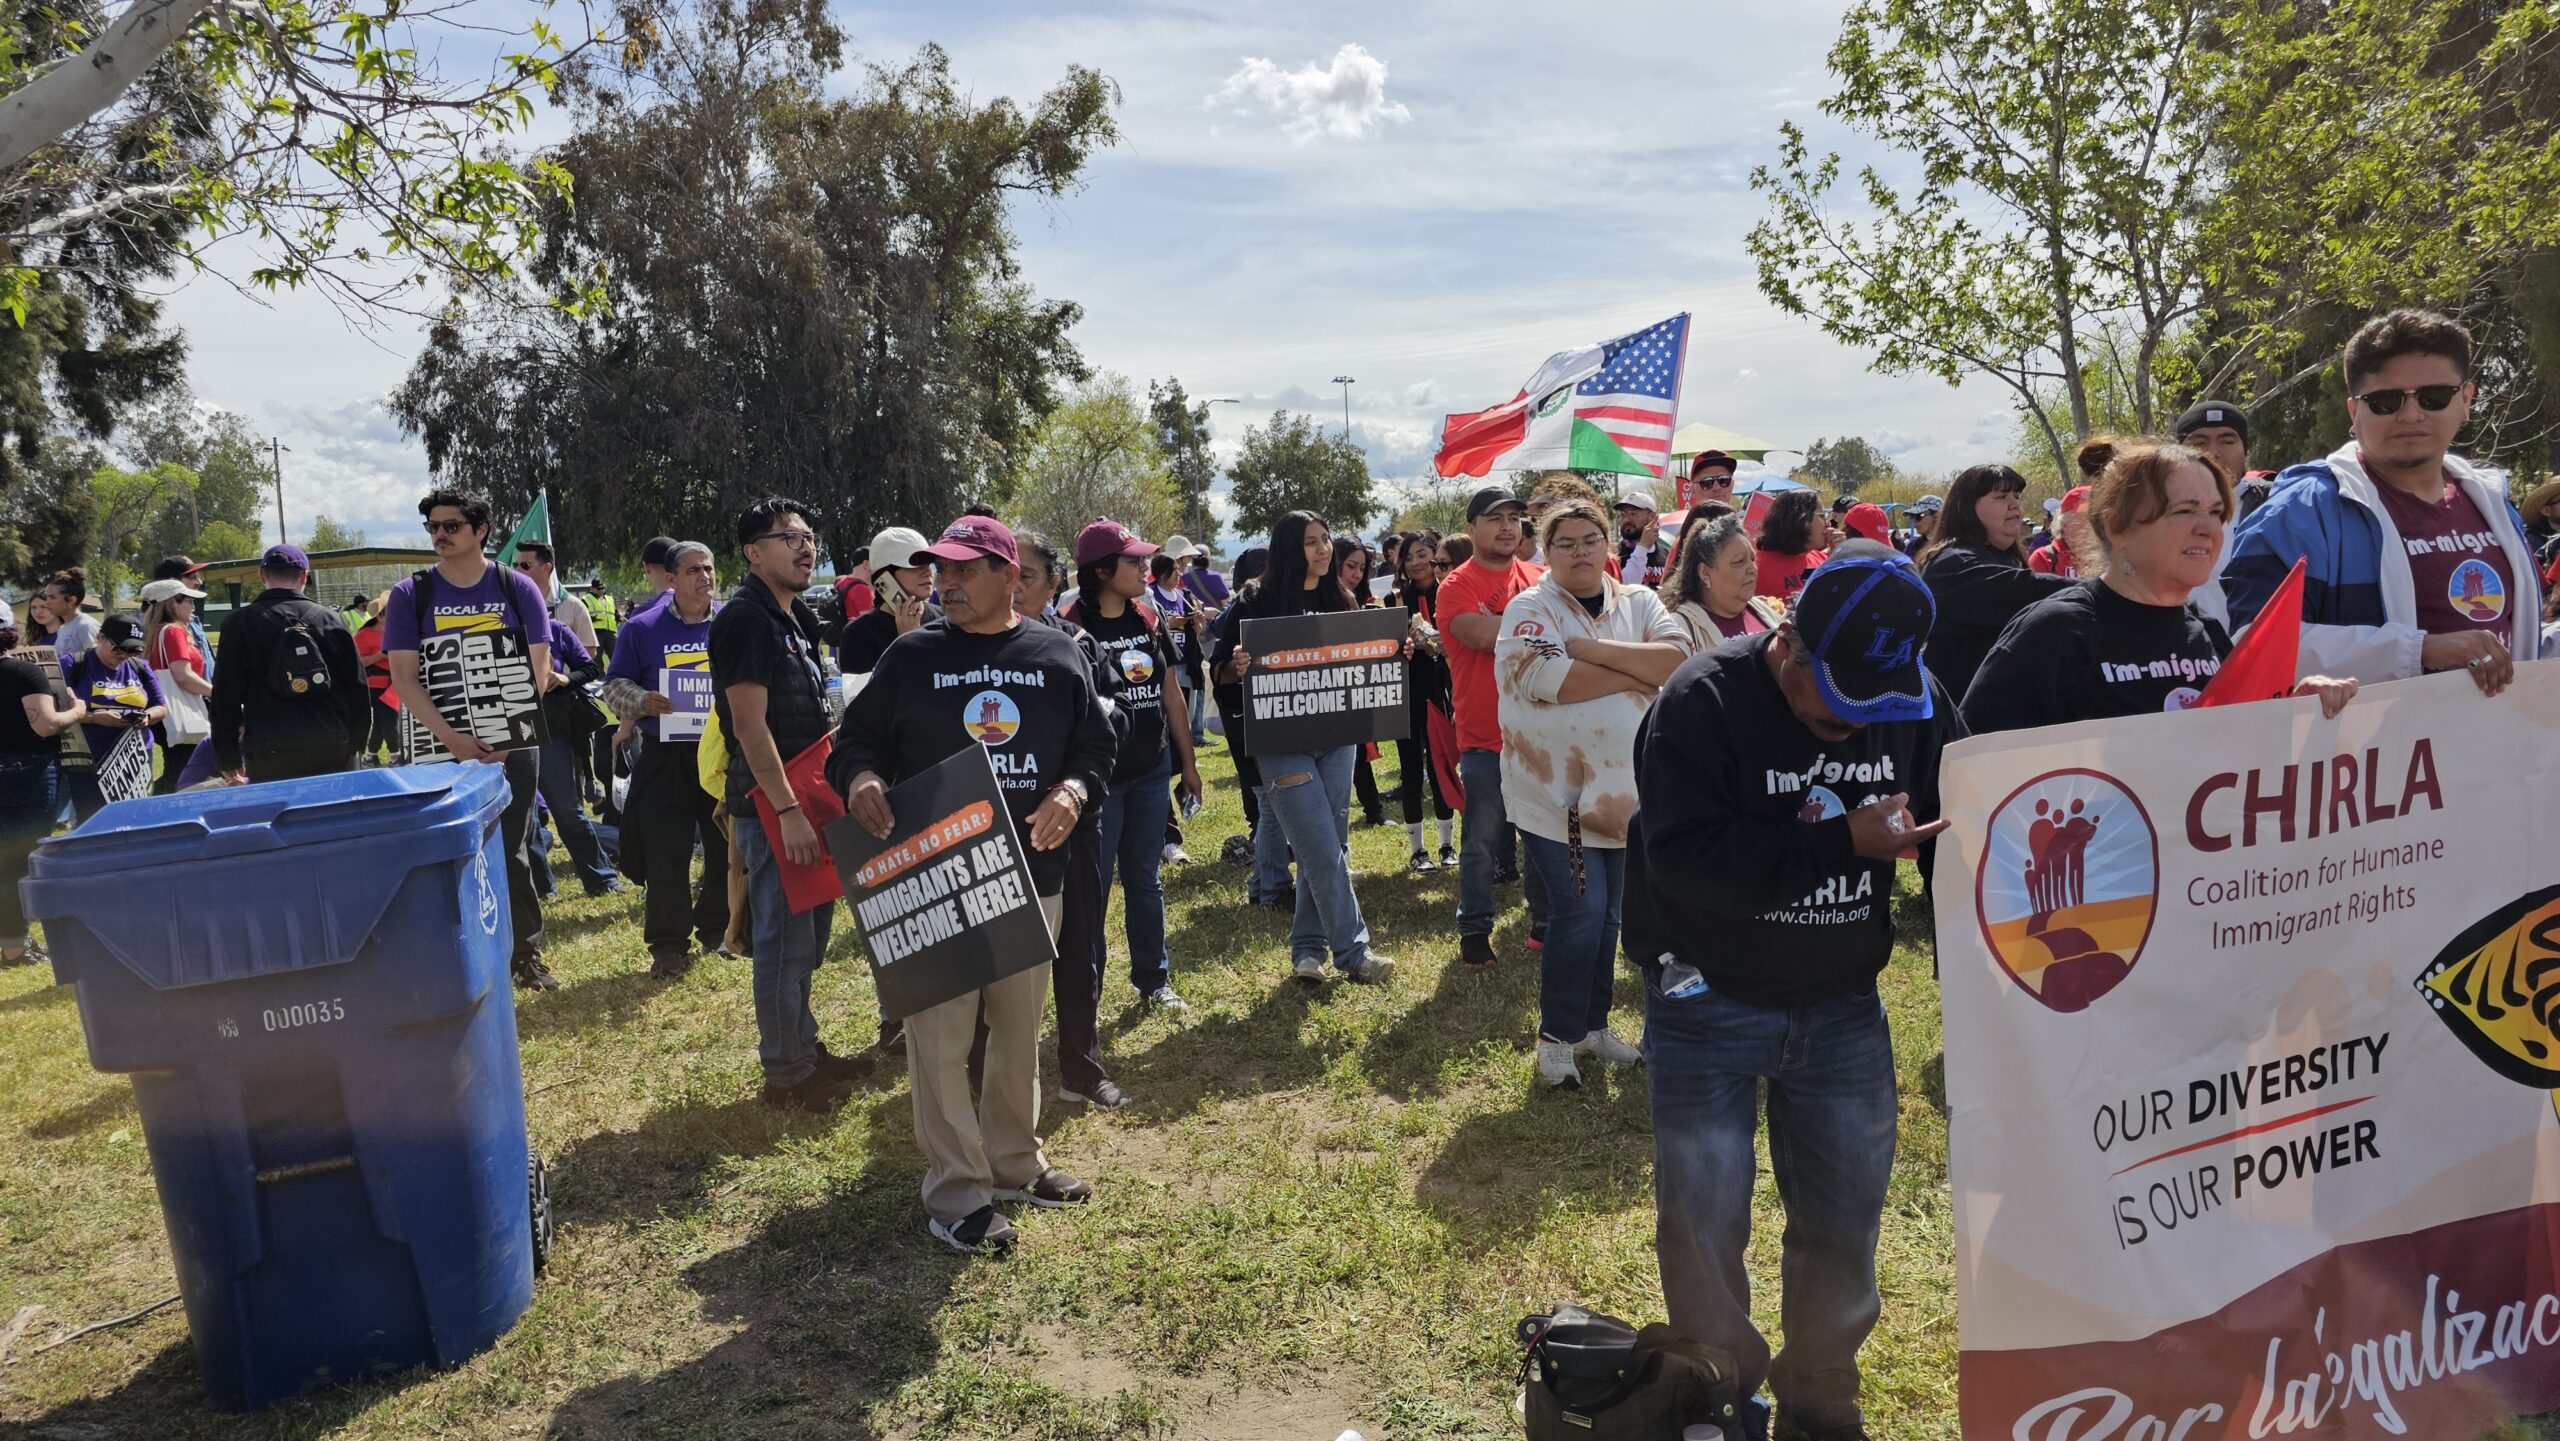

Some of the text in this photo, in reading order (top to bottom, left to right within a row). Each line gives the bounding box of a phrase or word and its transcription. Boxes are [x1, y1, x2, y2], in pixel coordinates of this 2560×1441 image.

[434, 603, 506, 616] LOCAL 721
[664, 642, 707, 653] LOCAL
[1261, 645, 1393, 665] NO HATE, NO FEAR:
[1862, 626, 1915, 672] LA
[462, 635, 512, 744] WE FEED
[495, 656, 538, 718] YOU!
[1252, 661, 1402, 696] IMMIGRANTS ARE
[1253, 684, 1403, 720] WELCOME HERE!
[413, 717, 434, 757] WIT
[992, 753, 1038, 774] RLA
[101, 760, 121, 791] WITH
[2185, 738, 2444, 853] CHIRLA
[856, 812, 988, 885] NO HATE, NO FEAR:
[2187, 838, 2445, 907] Coalition for Humane
[857, 834, 1015, 932] IMMIGRANTS ARE
[1792, 870, 1873, 908] RLA
[868, 869, 1028, 968] WELCOME HERE!
[2213, 884, 2416, 949] Immigrant Rights
[2093, 1031, 2390, 1152] OUR DIVERSITY
[2112, 1119, 2381, 1250] IS OUR POWER
